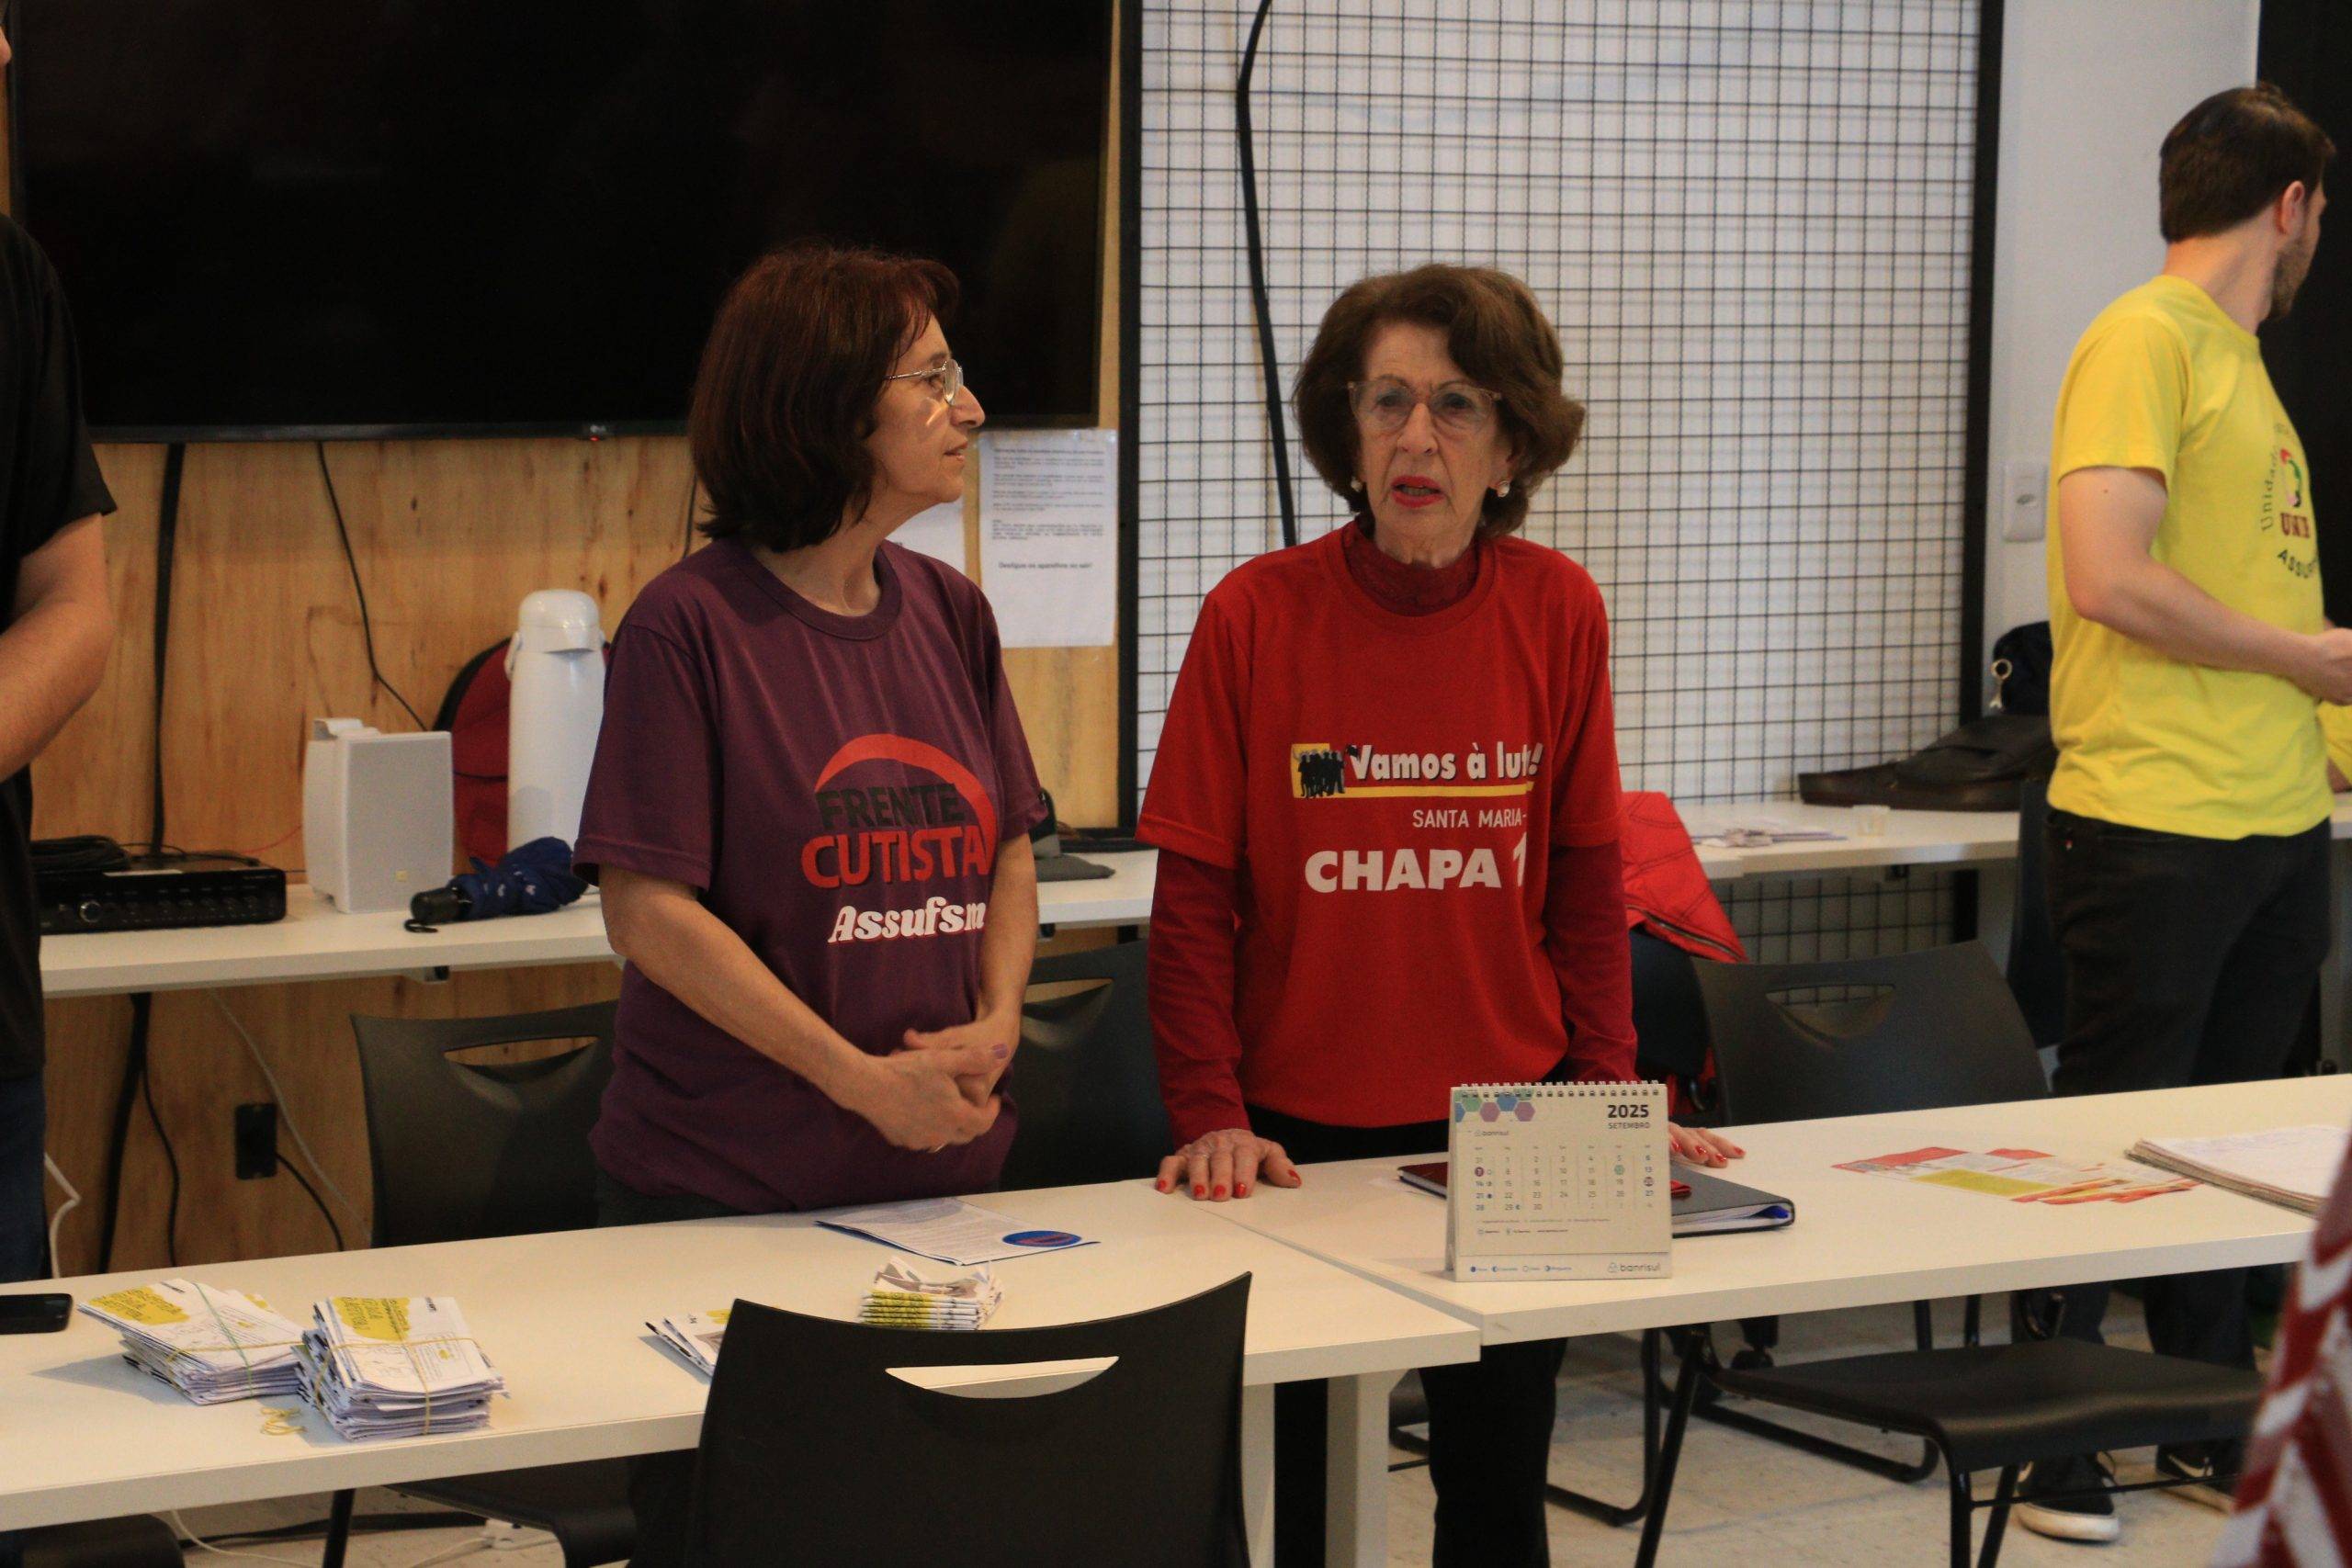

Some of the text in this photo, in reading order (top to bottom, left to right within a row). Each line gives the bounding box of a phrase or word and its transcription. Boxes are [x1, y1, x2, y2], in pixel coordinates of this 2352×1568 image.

[1348, 740, 1544, 780] Vamos à lut!
[815, 783, 963, 828] FRENTE
[1412, 809, 1470, 828] SANTA
[801, 825, 989, 888] CUTISTA
[1305, 831, 1527, 893] CHAPA 1
[828, 896, 987, 943] Assufsm
[1608, 1104, 1649, 1118] 2025
[1608, 1122, 1651, 1130] SETEMBRO
[1620, 1262, 1661, 1272] banrisul
